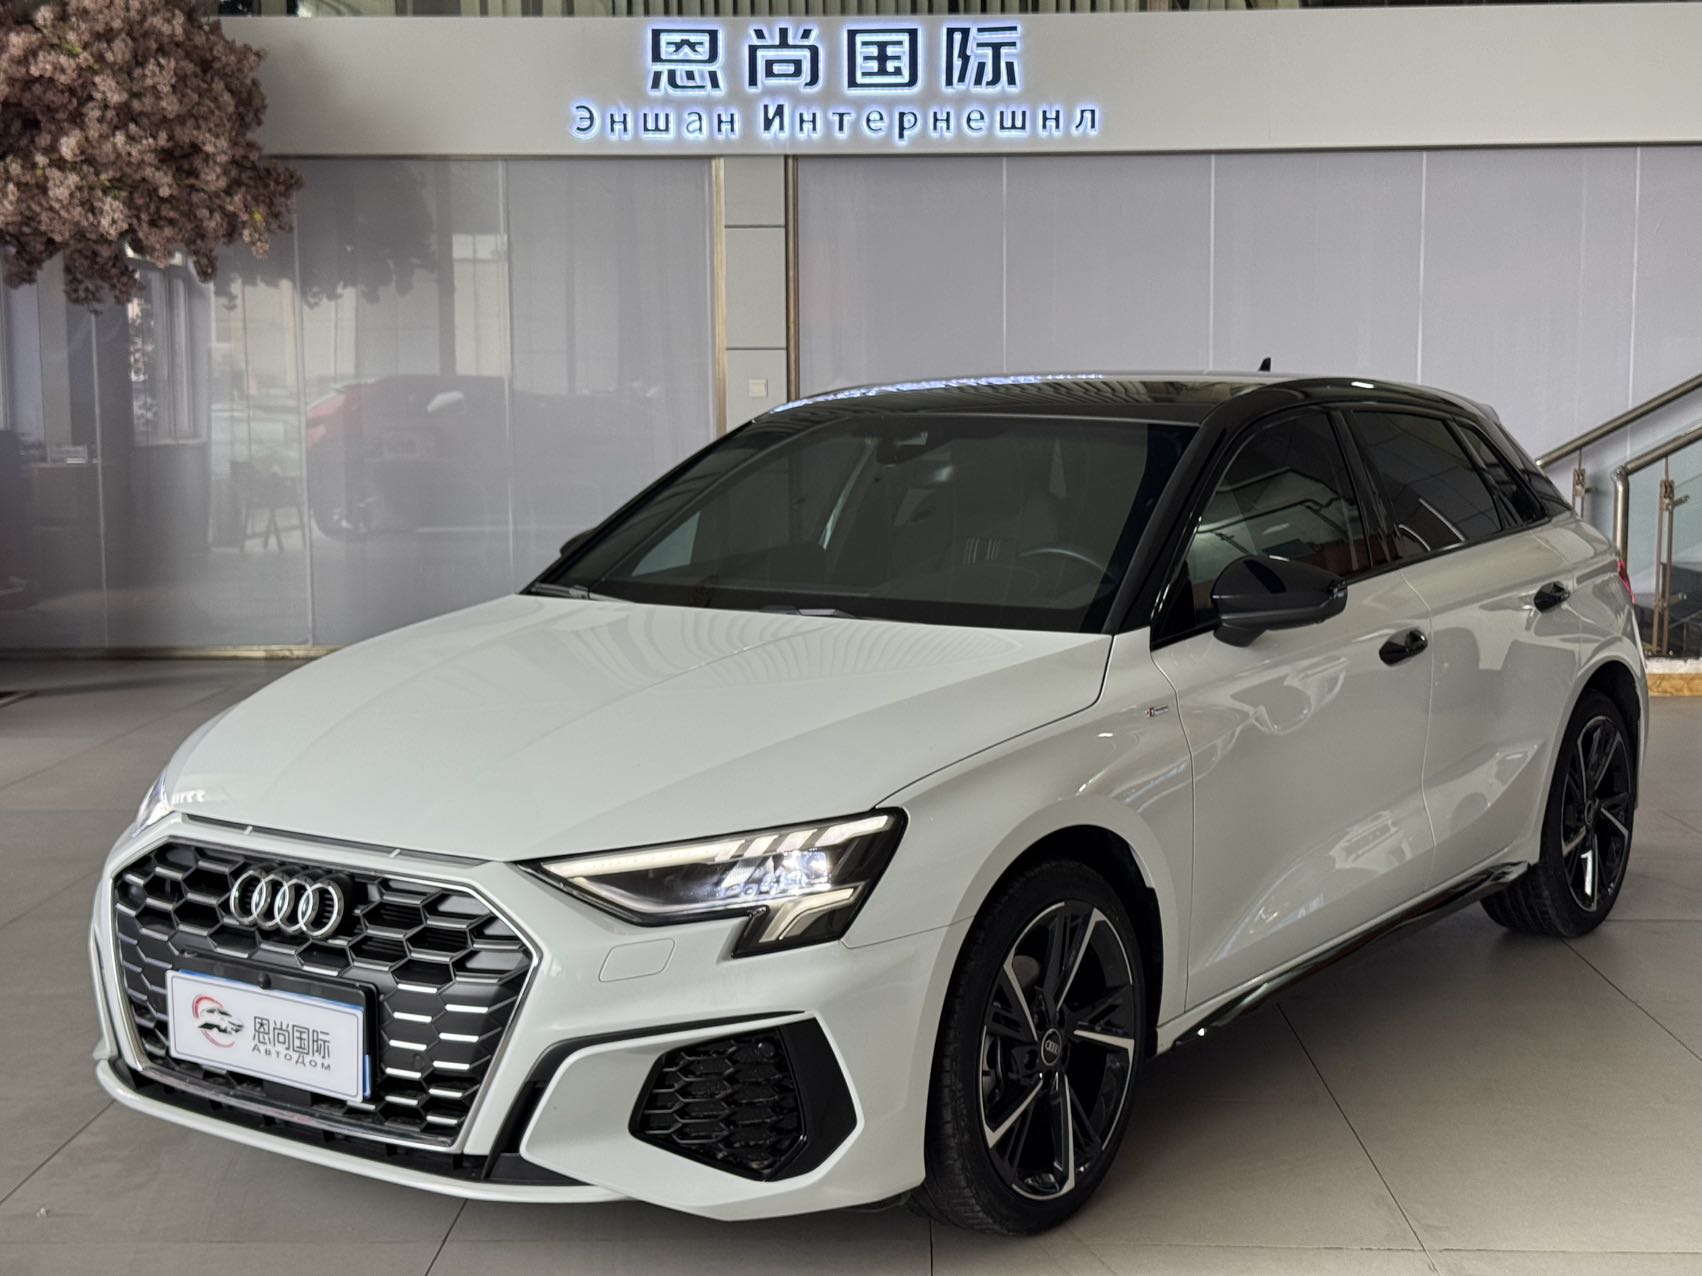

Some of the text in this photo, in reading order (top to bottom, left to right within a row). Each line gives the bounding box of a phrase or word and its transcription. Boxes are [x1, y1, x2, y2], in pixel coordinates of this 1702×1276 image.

[651, 27, 1019, 89] 恩尚国际
[574, 104, 1097, 139] Эншан Интернешнл
[253, 1016, 330, 1059] 恩尚国际
